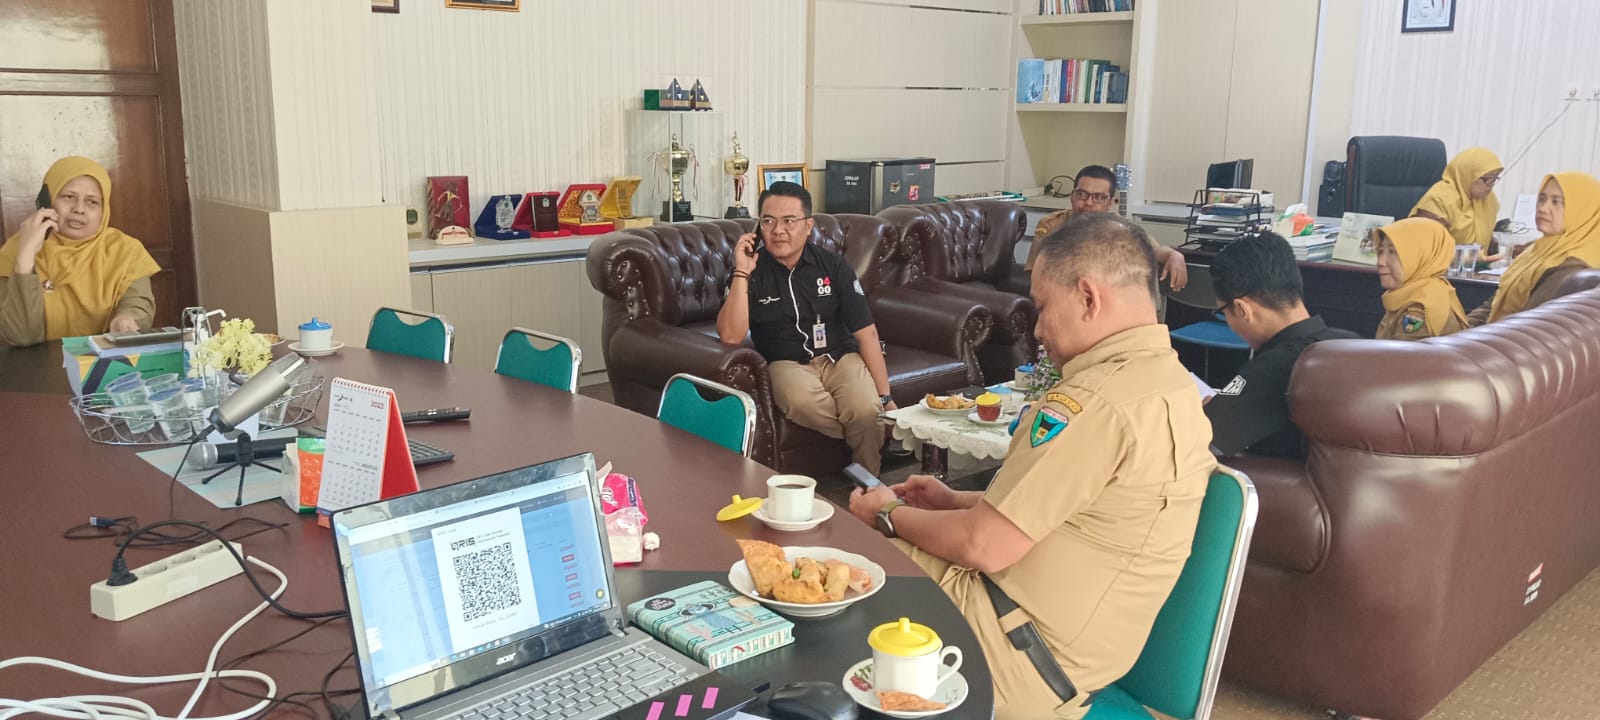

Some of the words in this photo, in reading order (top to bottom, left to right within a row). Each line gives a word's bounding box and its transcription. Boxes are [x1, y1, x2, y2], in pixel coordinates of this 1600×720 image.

[818, 285, 832, 294] 00
[370, 400, 385, 410] 2023
[451, 537, 476, 551] QRIS
[496, 652, 517, 665] acer
